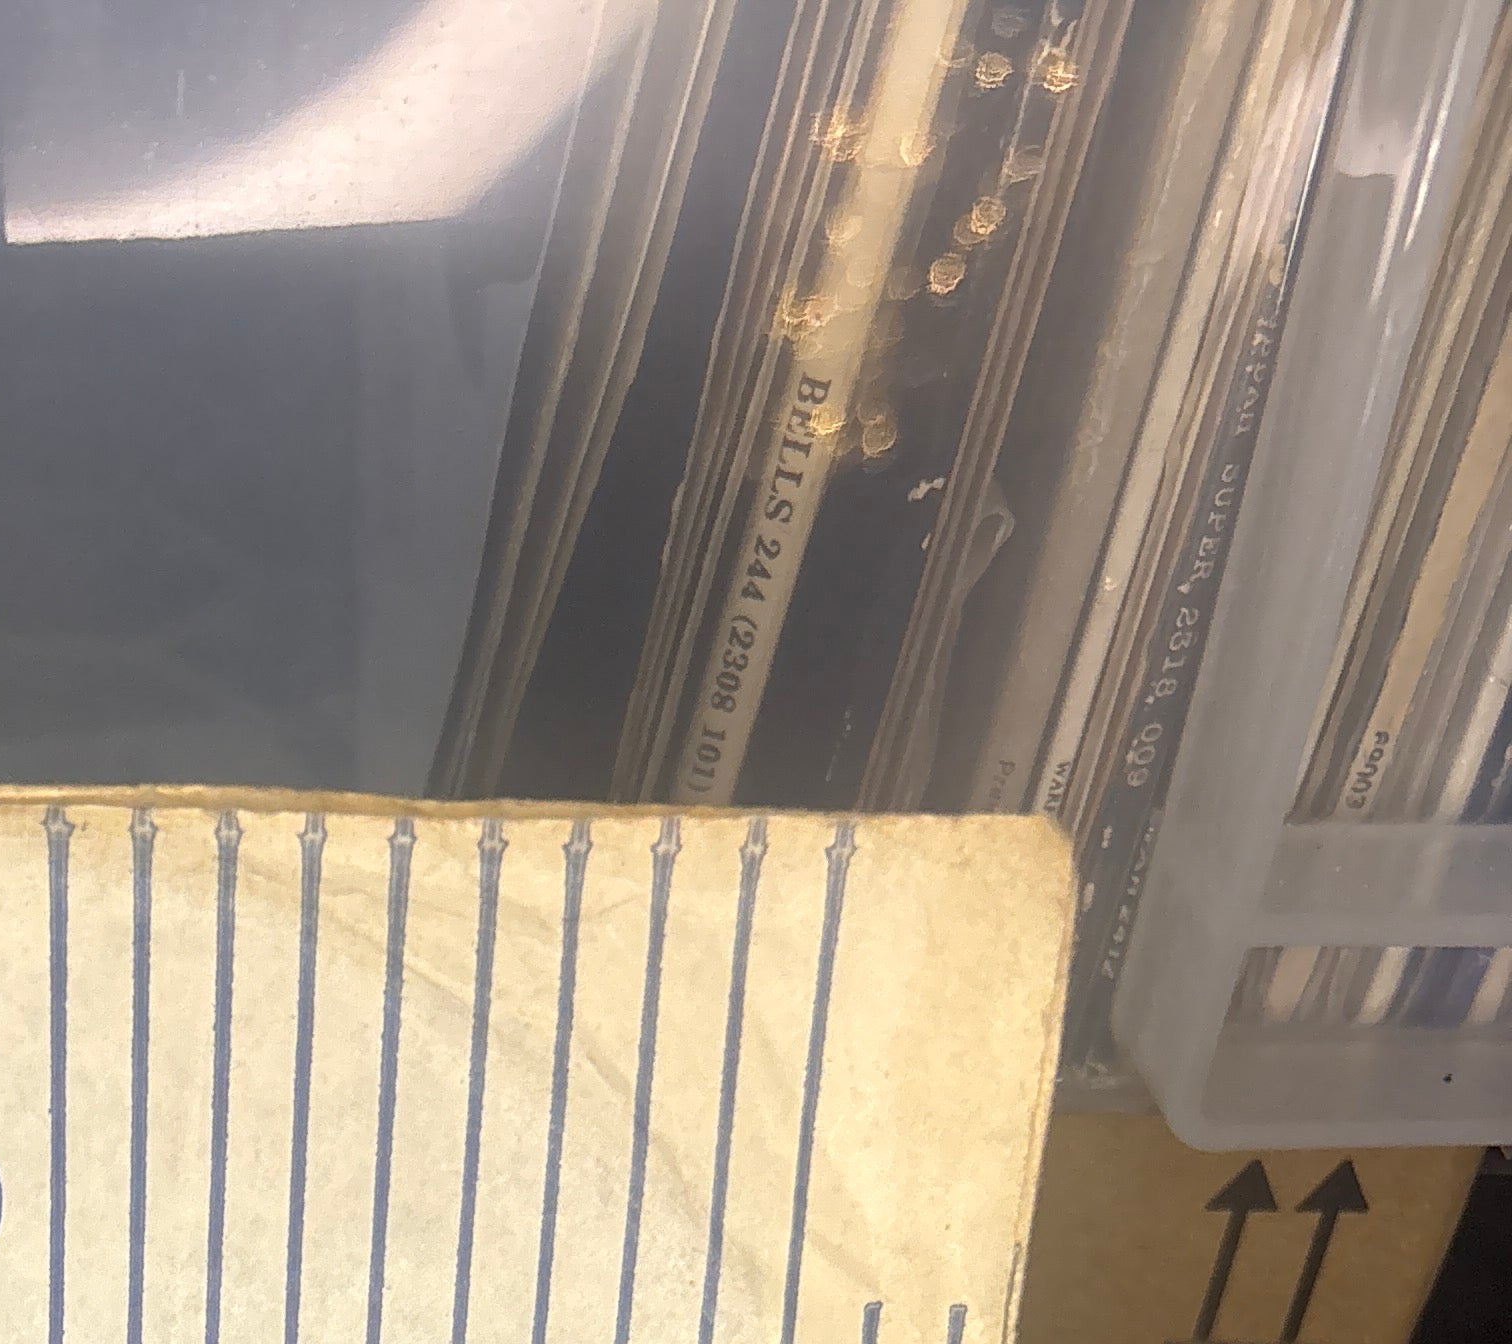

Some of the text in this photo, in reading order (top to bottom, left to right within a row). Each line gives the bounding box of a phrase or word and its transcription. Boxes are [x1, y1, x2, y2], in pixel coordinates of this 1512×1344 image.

[687, 371, 833, 793] BELLS 244 (2308 101)
